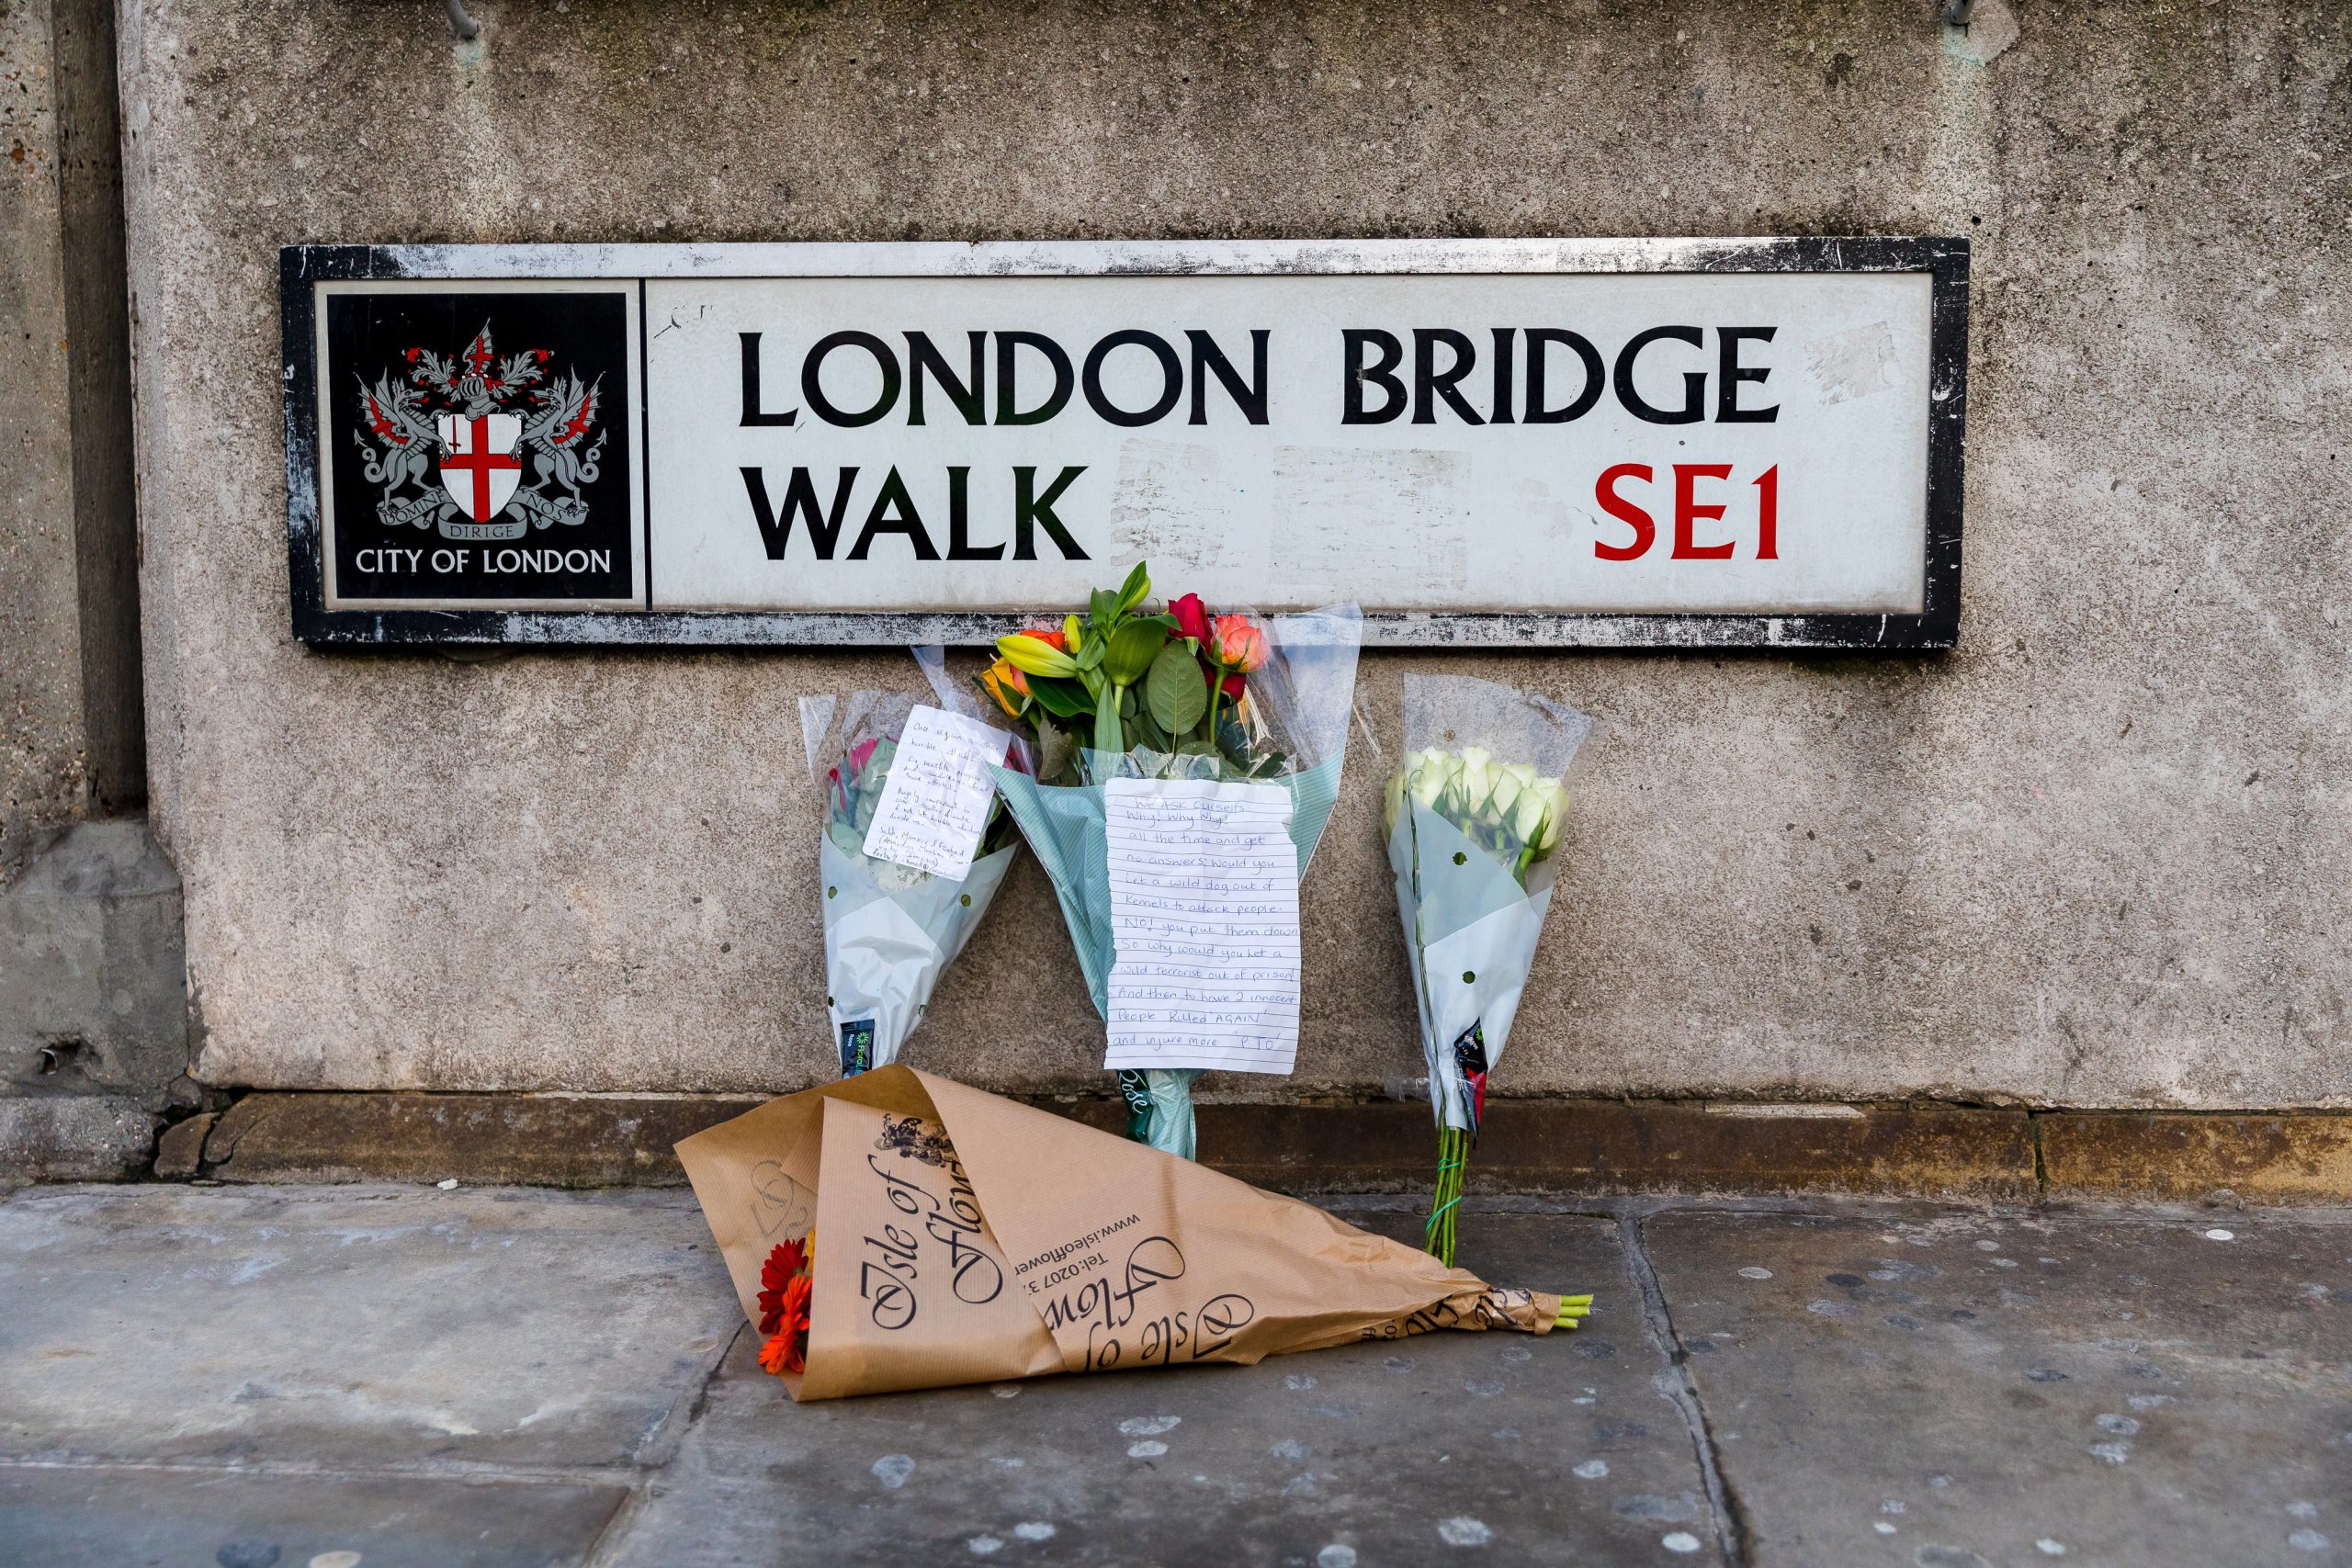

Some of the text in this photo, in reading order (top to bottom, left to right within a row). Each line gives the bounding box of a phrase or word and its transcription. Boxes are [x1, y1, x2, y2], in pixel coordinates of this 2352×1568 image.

[739, 325, 1781, 428] LONDON BRIDGE
[384, 491, 567, 538] DOMINE DIRIGE NOS
[739, 462, 1779, 562] WALK SE1
[356, 548, 612, 574] CITY OF LONDON
[1154, 832, 1173, 843] the
[1182, 832, 1211, 844] time
[1216, 835, 1239, 844] and
[1244, 836, 1265, 851] get
[1253, 861, 1274, 875] you
[1125, 873, 1147, 885] Let
[1152, 877, 1160, 886] a
[1205, 879, 1228, 896] dog
[1233, 882, 1258, 890] out
[1263, 878, 1274, 891] of
[1175, 902, 1184, 911] to
[1189, 904, 1229, 913] attack
[1161, 922, 1183, 936] you
[1190, 925, 1213, 937] put
[1226, 925, 1260, 936] them
[1264, 928, 1299, 936] down
[1178, 945, 1215, 955] would
[1221, 950, 1243, 963] you
[1156, 964, 1203, 977] terrorist
[1235, 969, 1248, 979] of
[1118, 987, 1297, 1004] And then to have 2 innocent
[1113, 1032, 1136, 1045] and
[1146, 1036, 1182, 1051] injure
[860, 1153, 941, 1330] Isle of
[1141, 1293, 1255, 1367] Isle
